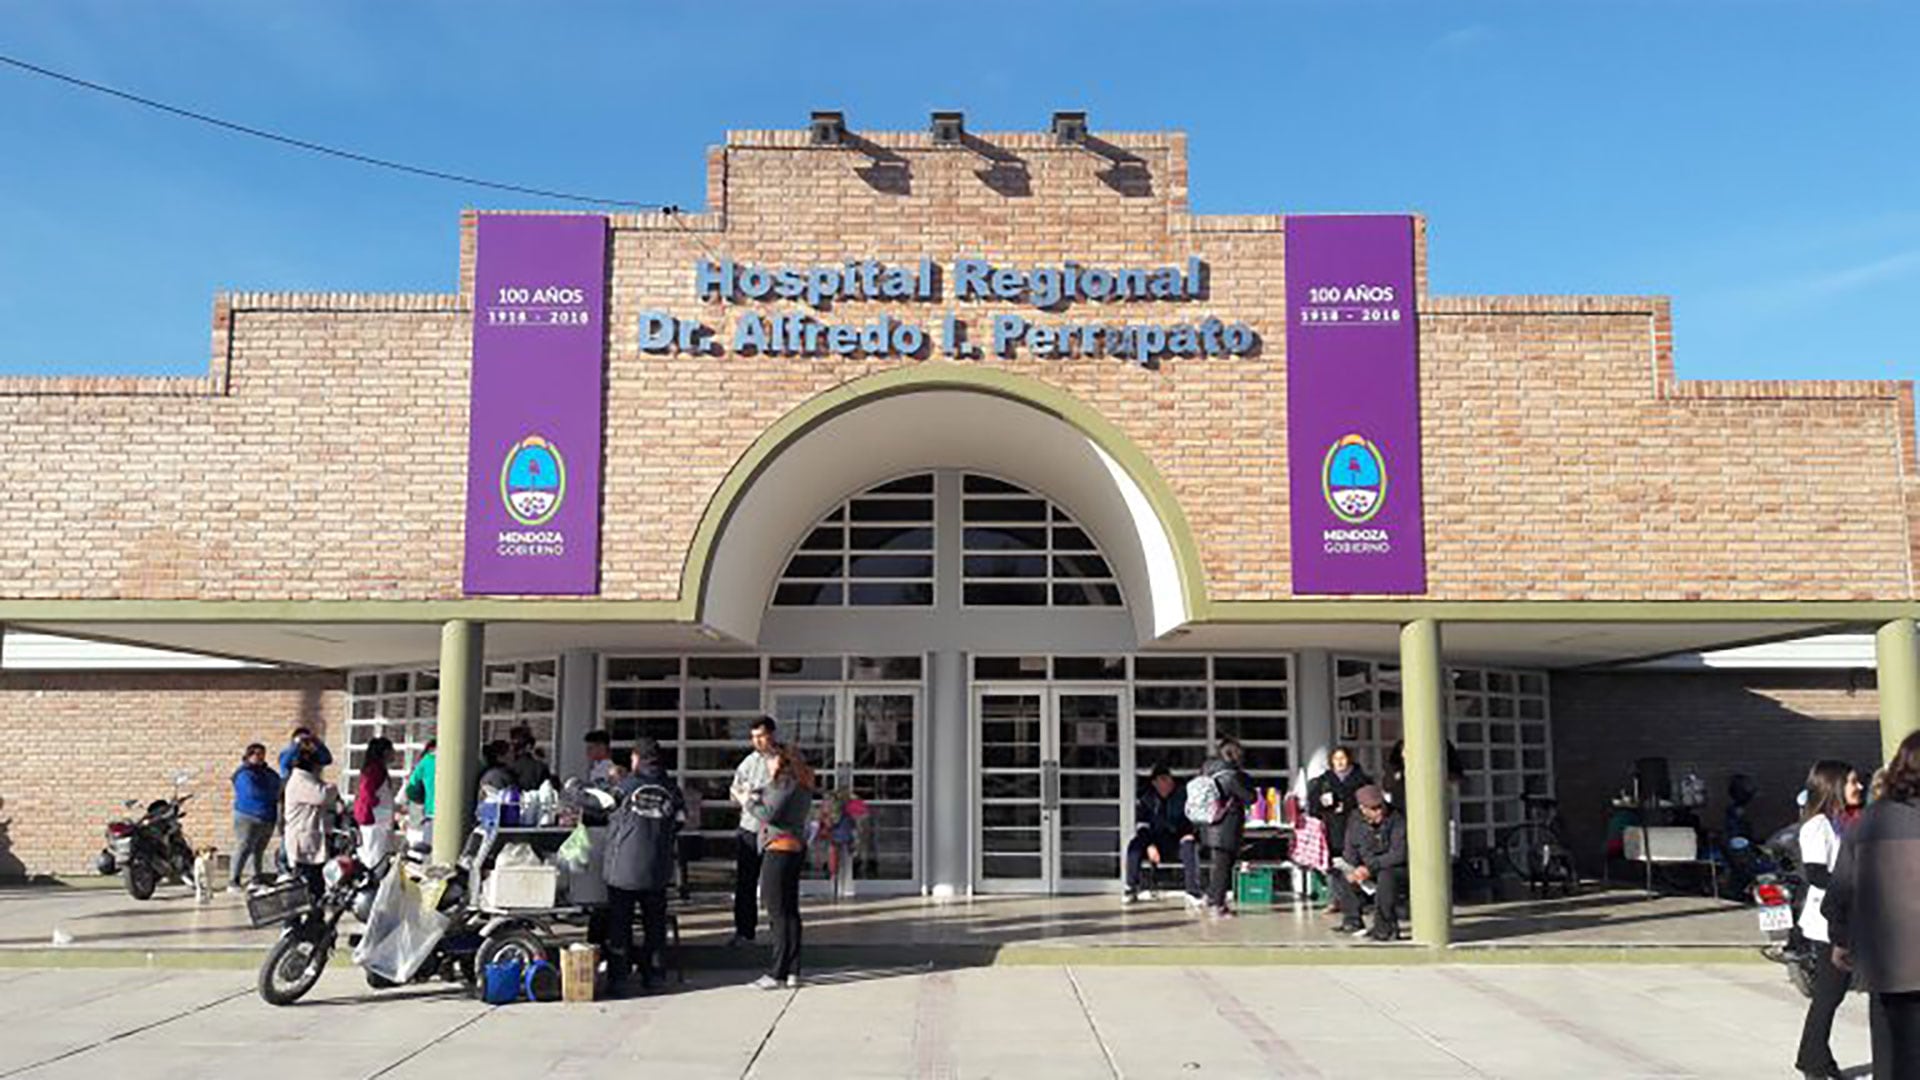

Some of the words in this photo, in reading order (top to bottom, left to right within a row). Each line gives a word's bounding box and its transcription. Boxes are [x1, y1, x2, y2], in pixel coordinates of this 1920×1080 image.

[696, 258, 932, 305] Hospital
[954, 256, 1201, 306] Regional
[499, 288, 529, 304] 100
[532, 286, 584, 304] AÑOS
[1310, 287, 1340, 303] 100
[1343, 284, 1394, 302] AÑOS
[488, 311, 527, 324] 1918
[549, 311, 589, 325] 2018
[1301, 310, 1339, 322] 1918
[1361, 308, 1401, 321] 2018
[639, 310, 711, 351] Dr.
[732, 310, 923, 354] Alfredo
[943, 311, 974, 354] I.
[993, 313, 1255, 363] Perrupato
[498, 531, 564, 543] MENDOZA
[1323, 530, 1389, 541] MENDOZA
[496, 544, 564, 556] GOBIERNO
[1323, 542, 1391, 553] GOBIERNO
